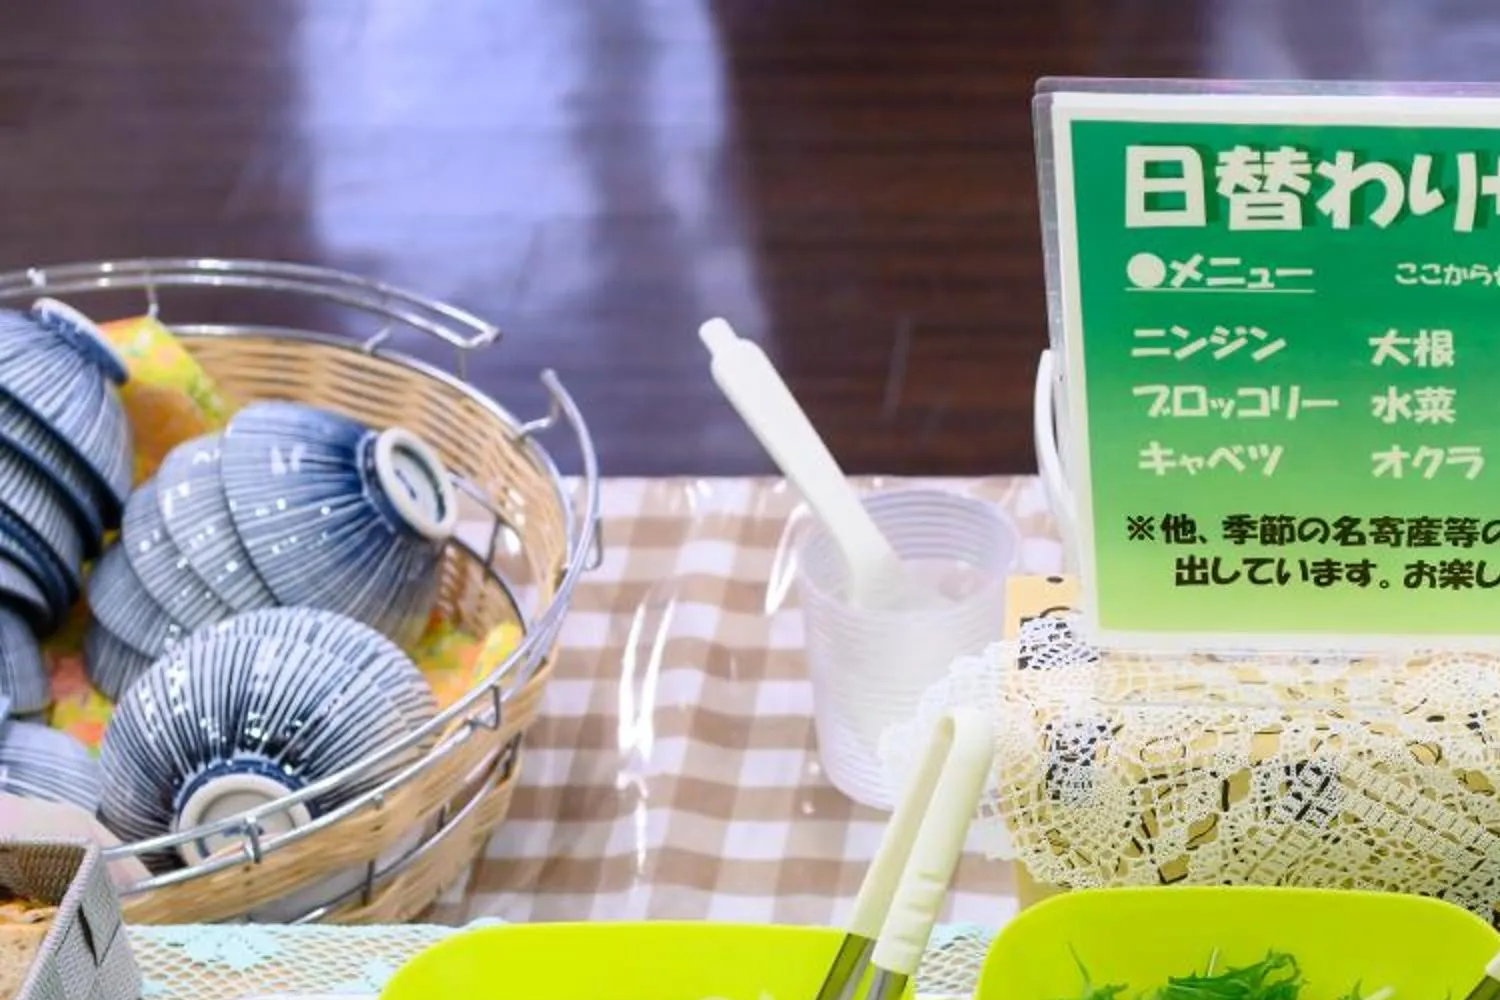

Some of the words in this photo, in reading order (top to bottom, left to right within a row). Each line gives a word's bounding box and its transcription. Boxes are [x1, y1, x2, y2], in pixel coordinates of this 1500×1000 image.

[1131, 325, 1287, 362] ニンジン
[1368, 328, 1456, 368] 大根
[1131, 384, 1340, 420] ブロッコリー
[1371, 386, 1457, 425] 水菜
[1138, 440, 1284, 477] キャベツ
[1371, 443, 1485, 480] オクラ
